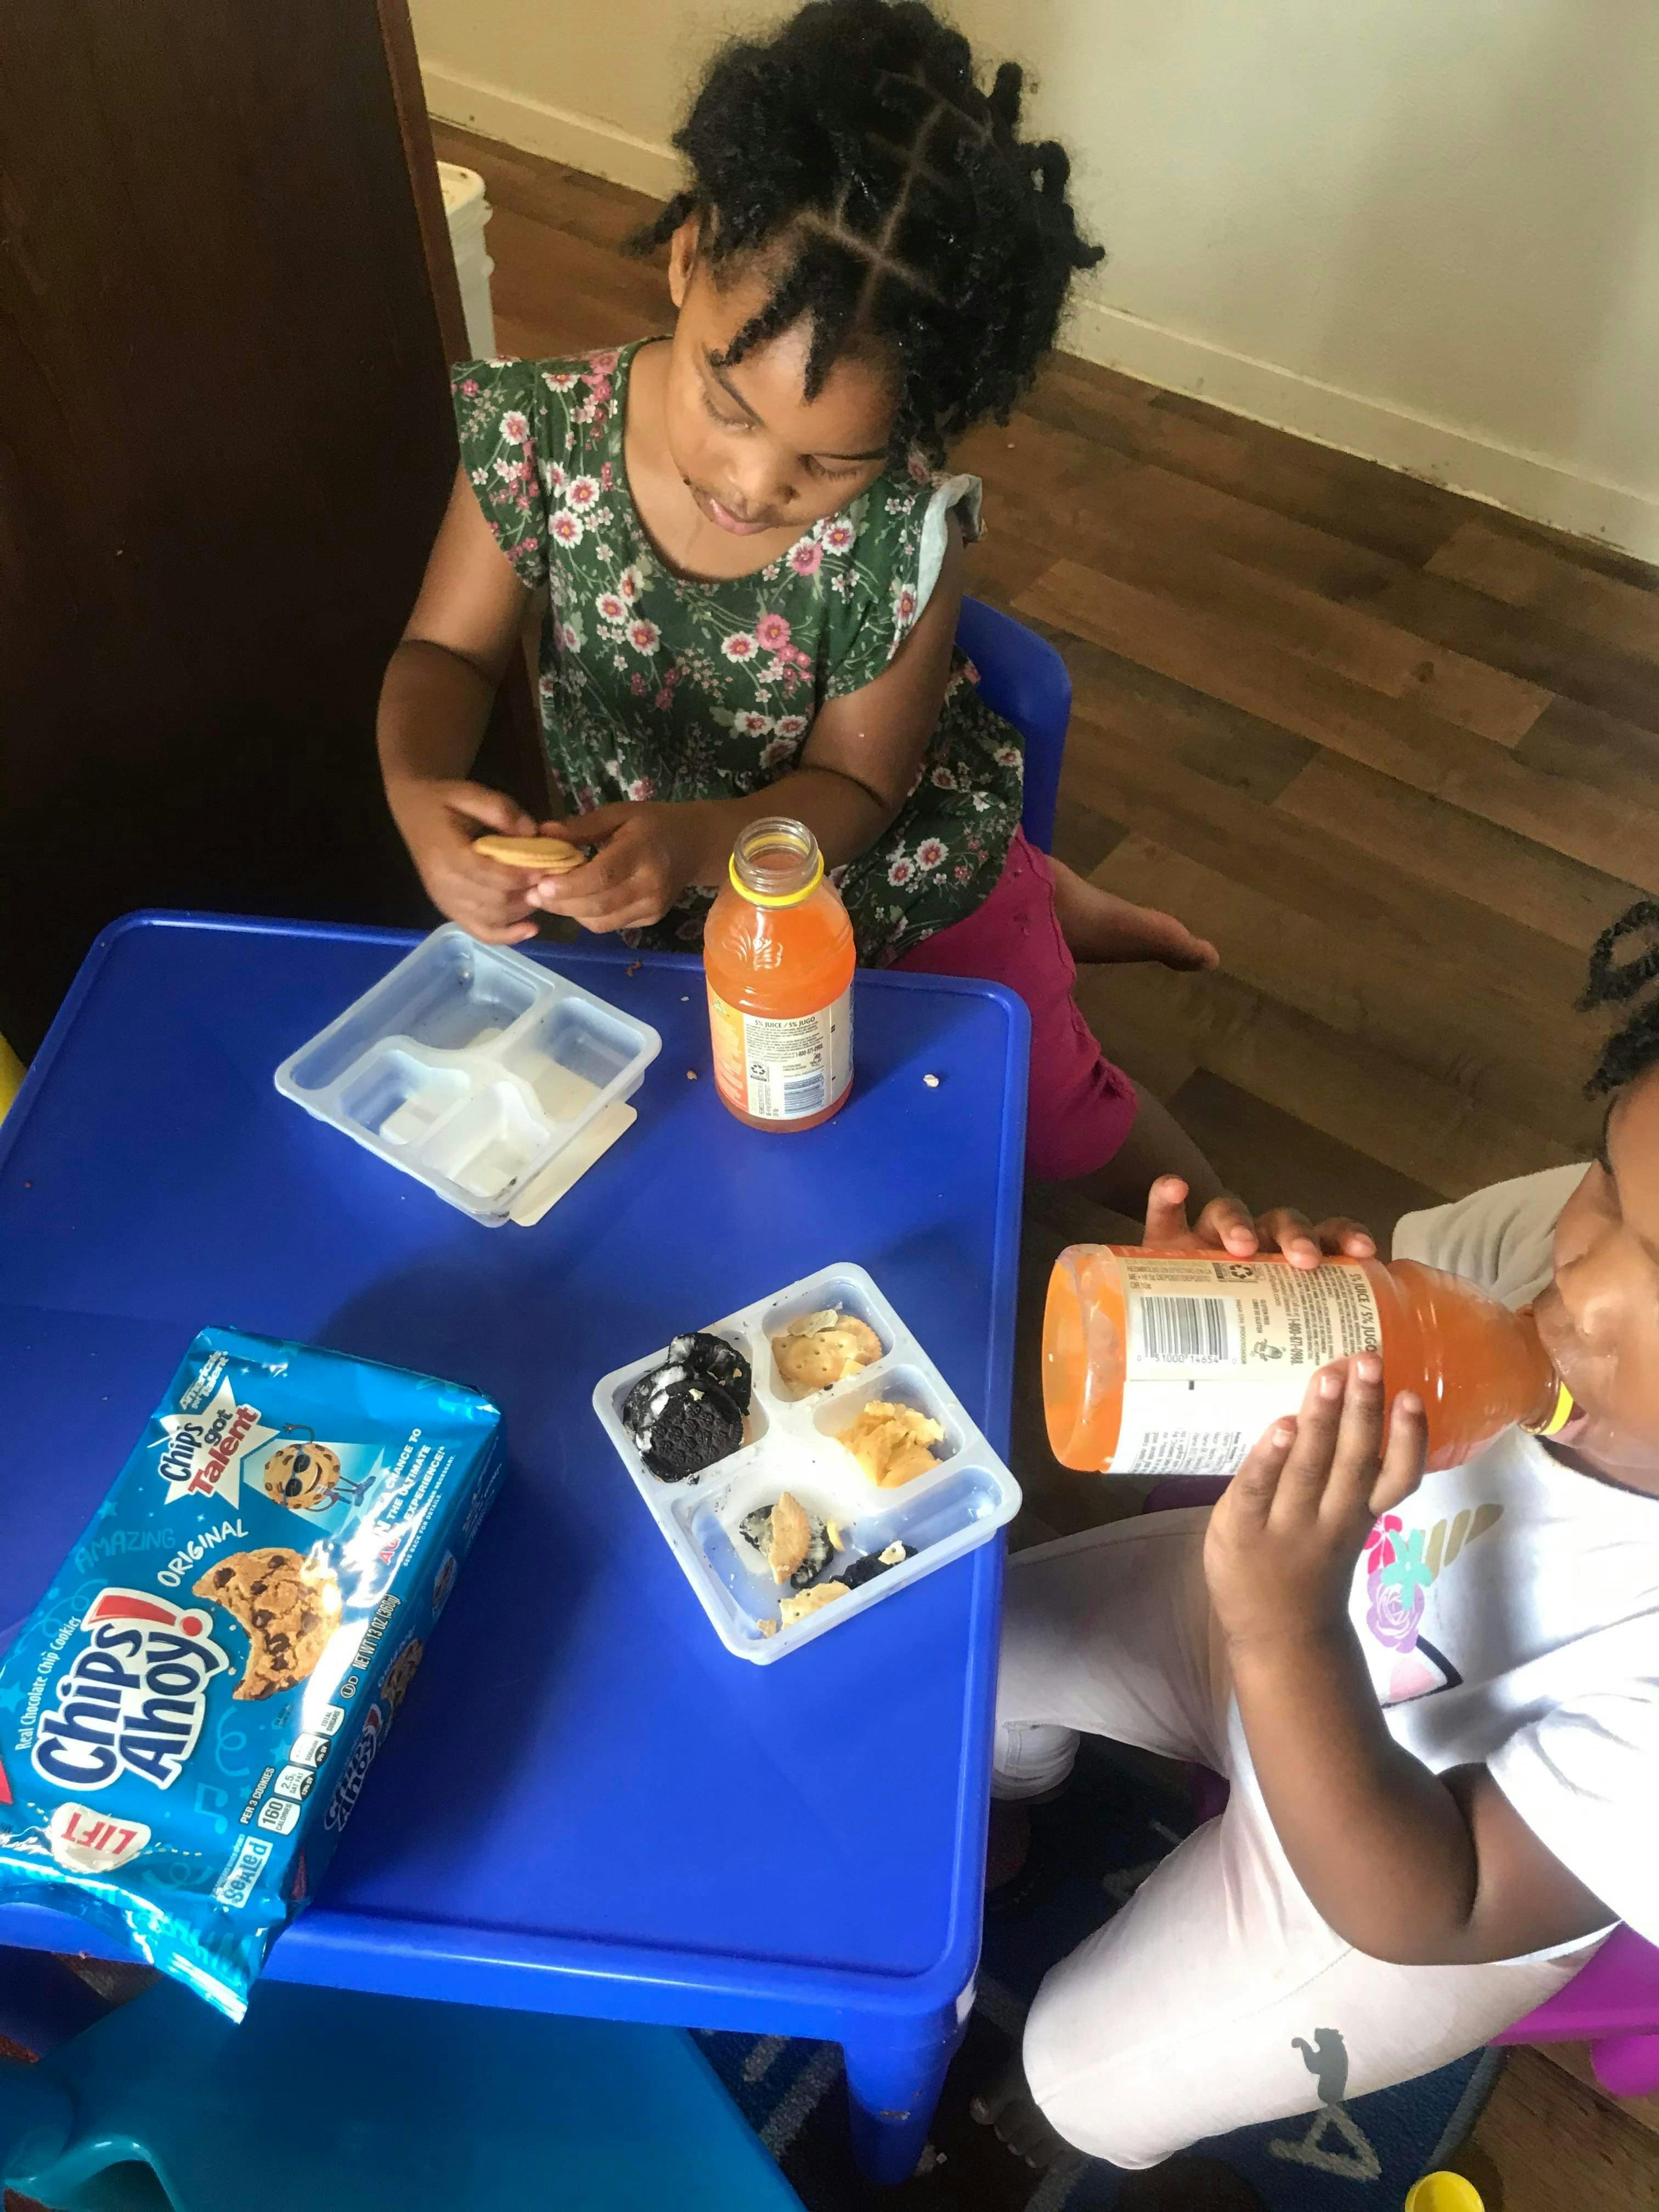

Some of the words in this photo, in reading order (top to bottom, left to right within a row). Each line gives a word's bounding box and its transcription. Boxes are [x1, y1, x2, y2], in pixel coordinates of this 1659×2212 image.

[799, 1016, 815, 1027] JUGO
[1350, 1273, 1362, 1282] 5%
[1351, 1283, 1370, 1303] JUICE
[1361, 1312, 1374, 1324] 5%
[1361, 1325, 1378, 1352] JUGO
[1154, 1353, 1184, 1363] 51000
[1190, 1355, 1219, 1364] 14654
[204, 1408, 234, 1447] got
[187, 1406, 259, 1495] Talent
[386, 1444, 414, 1489] CHANCE
[408, 1427, 422, 1443] TO
[386, 1497, 404, 1520] THE
[399, 1444, 432, 1497] ULTIMATE
[419, 1521, 429, 1534] FOR
[75, 1527, 176, 1574] AMAZING
[157, 1518, 249, 1587] ORIGINAL
[375, 1593, 402, 1619] (368g)
[50, 1616, 82, 1652] Cookies
[367, 1630, 383, 1640] 13
[371, 1616, 388, 1630] OZ
[359, 1639, 377, 1655] WT
[37, 1650, 56, 1677] Chip
[352, 1654, 371, 1671] NET
[21, 1675, 48, 1727] Chocolate
[36, 1623, 143, 1784] Chips
[321, 1711, 333, 1727] TOTAL
[326, 1710, 341, 1733] SUGARS
[15, 1726, 33, 1751] Real
[304, 1740, 320, 1762] SODIUM
[252, 1767, 275, 1800] COOKIES
[289, 1784, 300, 1795] SAT
[295, 1772, 304, 1784] FAT
[240, 1806, 256, 1825] PER
[249, 1798, 258, 1808] 3
[262, 1801, 284, 1826] 160
[275, 1803, 293, 1831] CALORIES
[60, 1812, 138, 1855] LIFT
